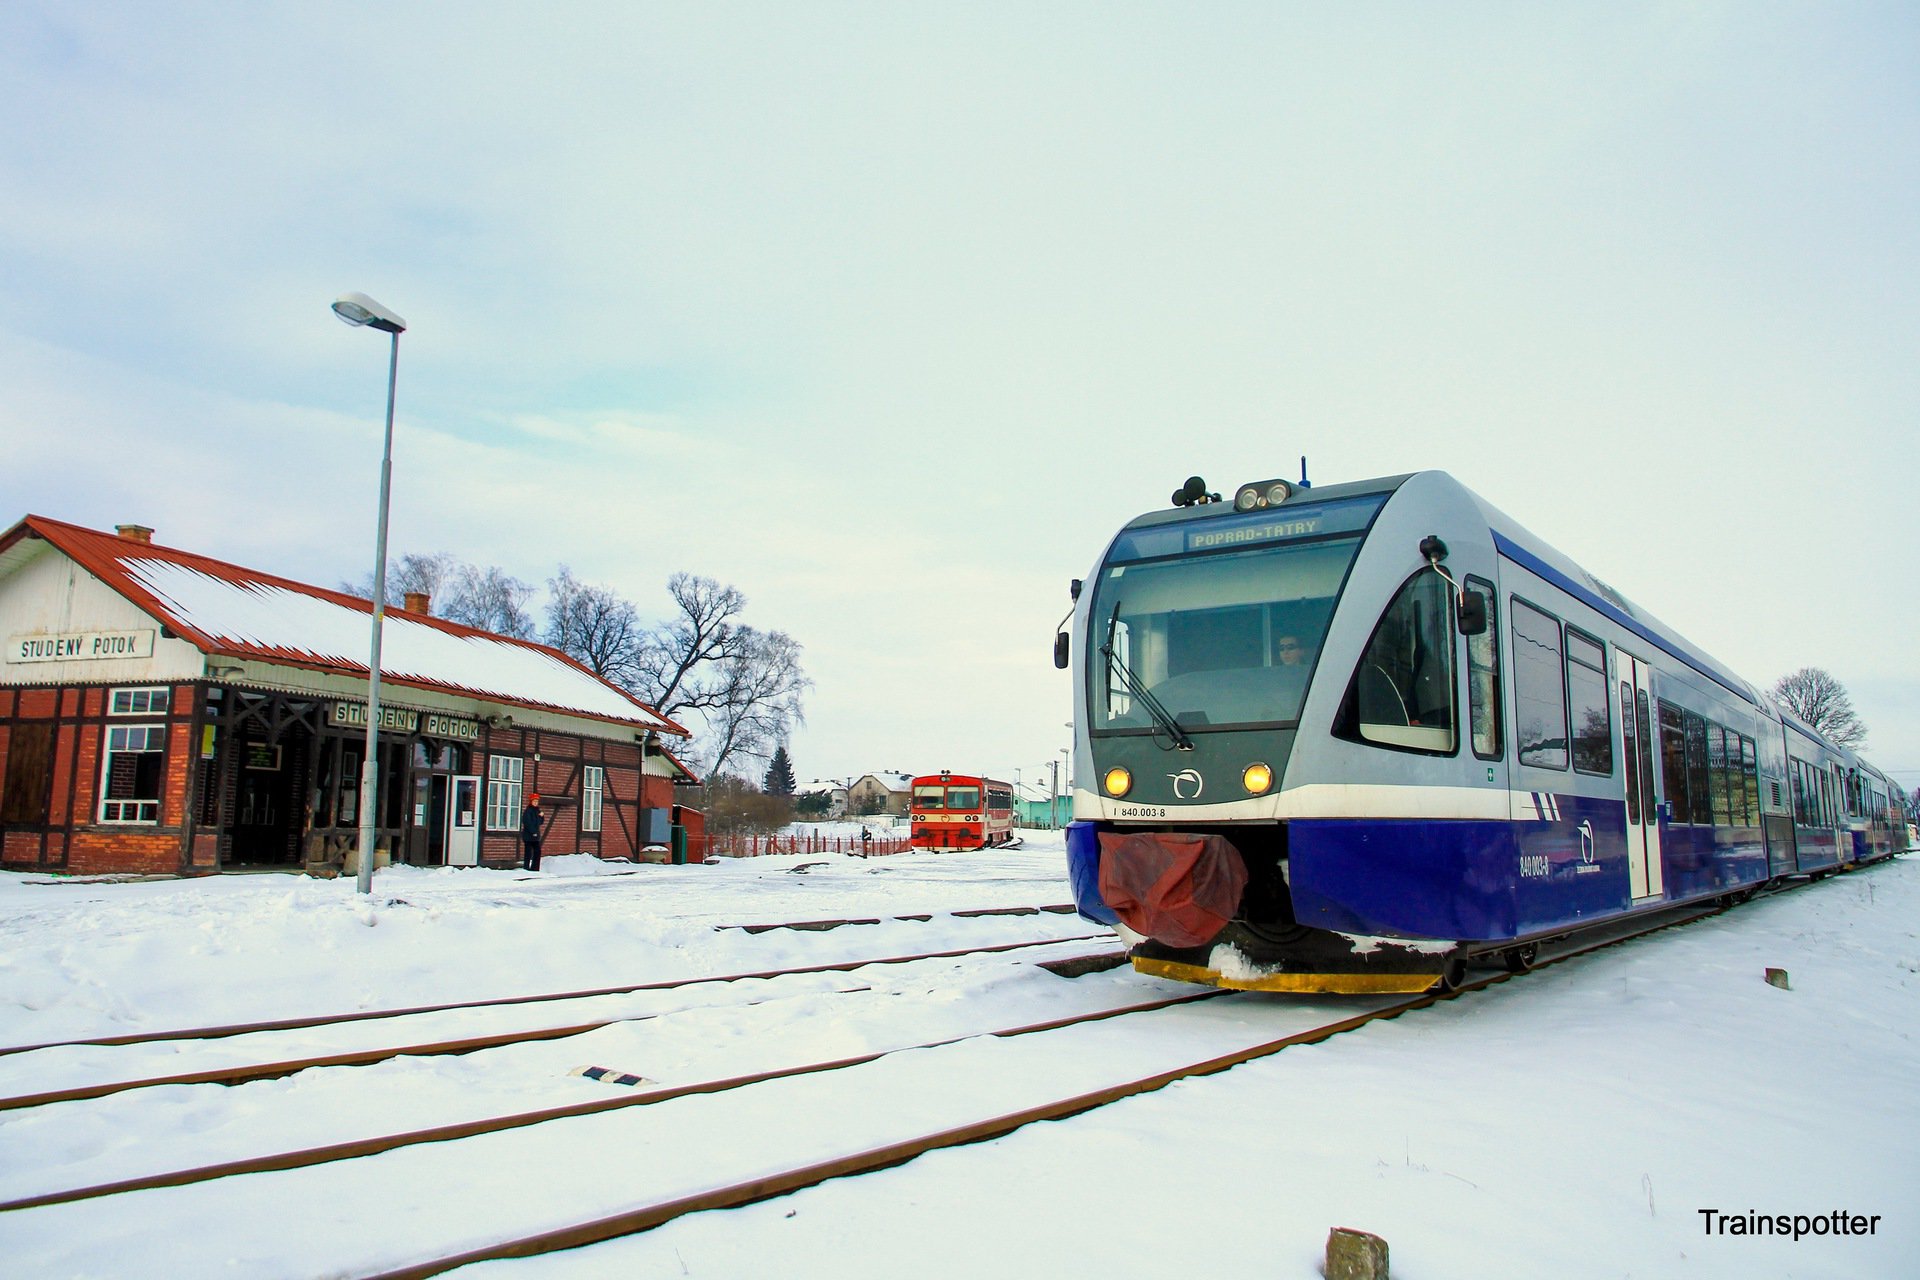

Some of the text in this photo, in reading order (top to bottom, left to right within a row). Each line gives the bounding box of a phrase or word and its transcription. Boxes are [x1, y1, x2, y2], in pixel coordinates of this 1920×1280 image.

[1195, 520, 1316, 547] POPRAD-TATRY
[21, 635, 136, 658] STUDENÝ POTOK
[429, 719, 477, 738] POTOK
